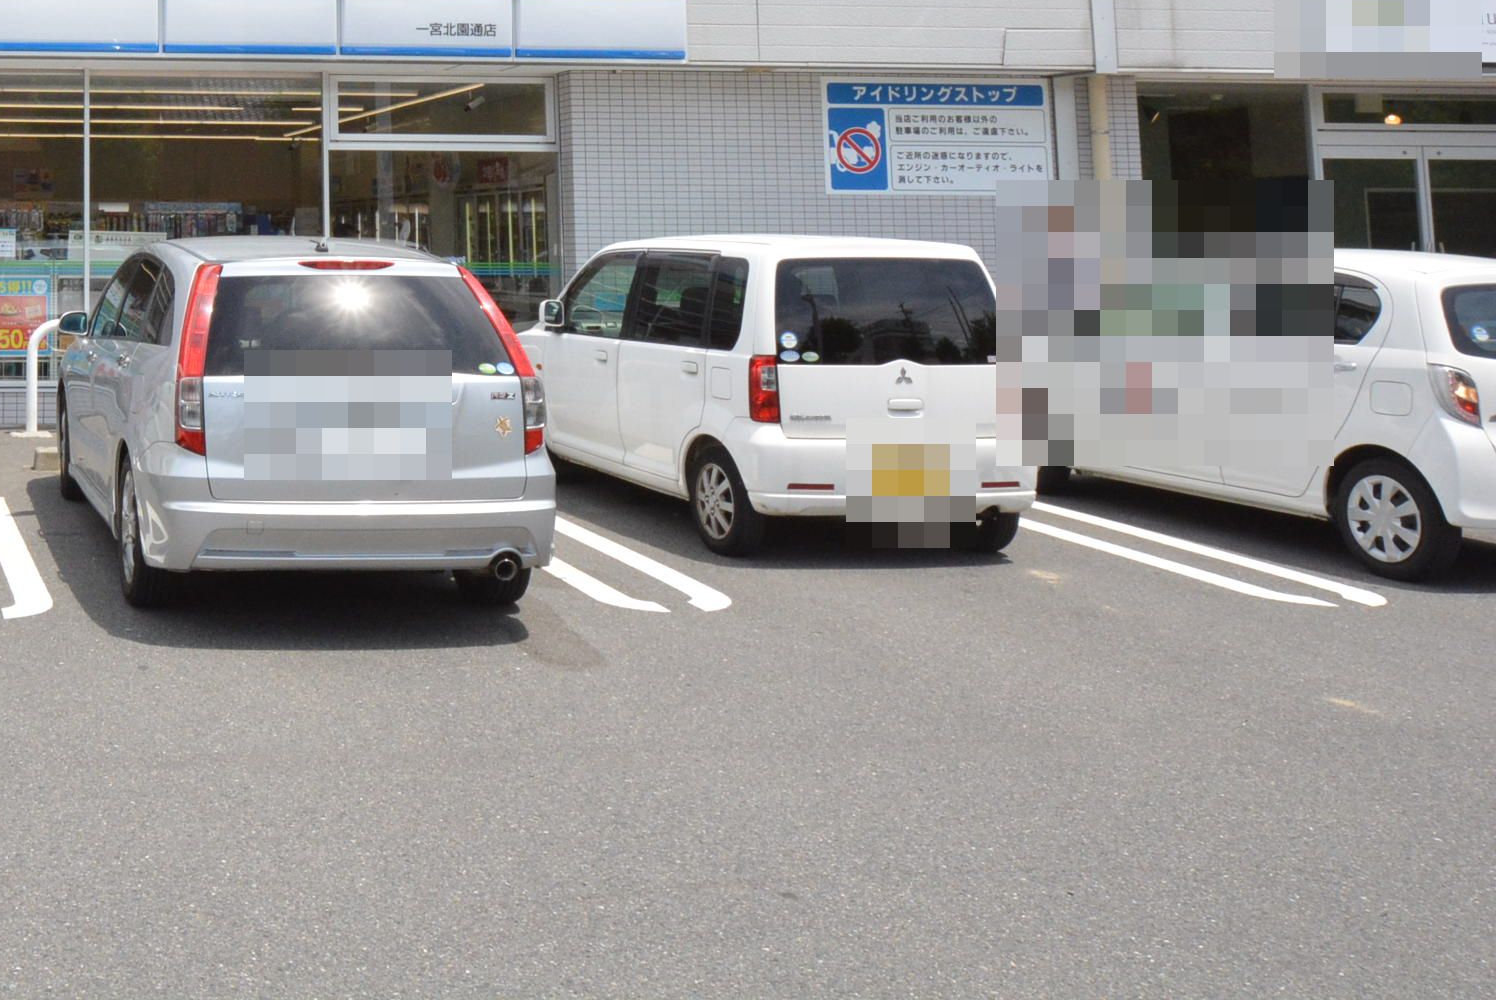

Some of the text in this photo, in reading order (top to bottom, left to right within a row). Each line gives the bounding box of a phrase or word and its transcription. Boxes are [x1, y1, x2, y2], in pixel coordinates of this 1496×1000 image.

[415, 22, 497, 37] 一宮北園通店
[852, 85, 1018, 102] アイドリングストップ
